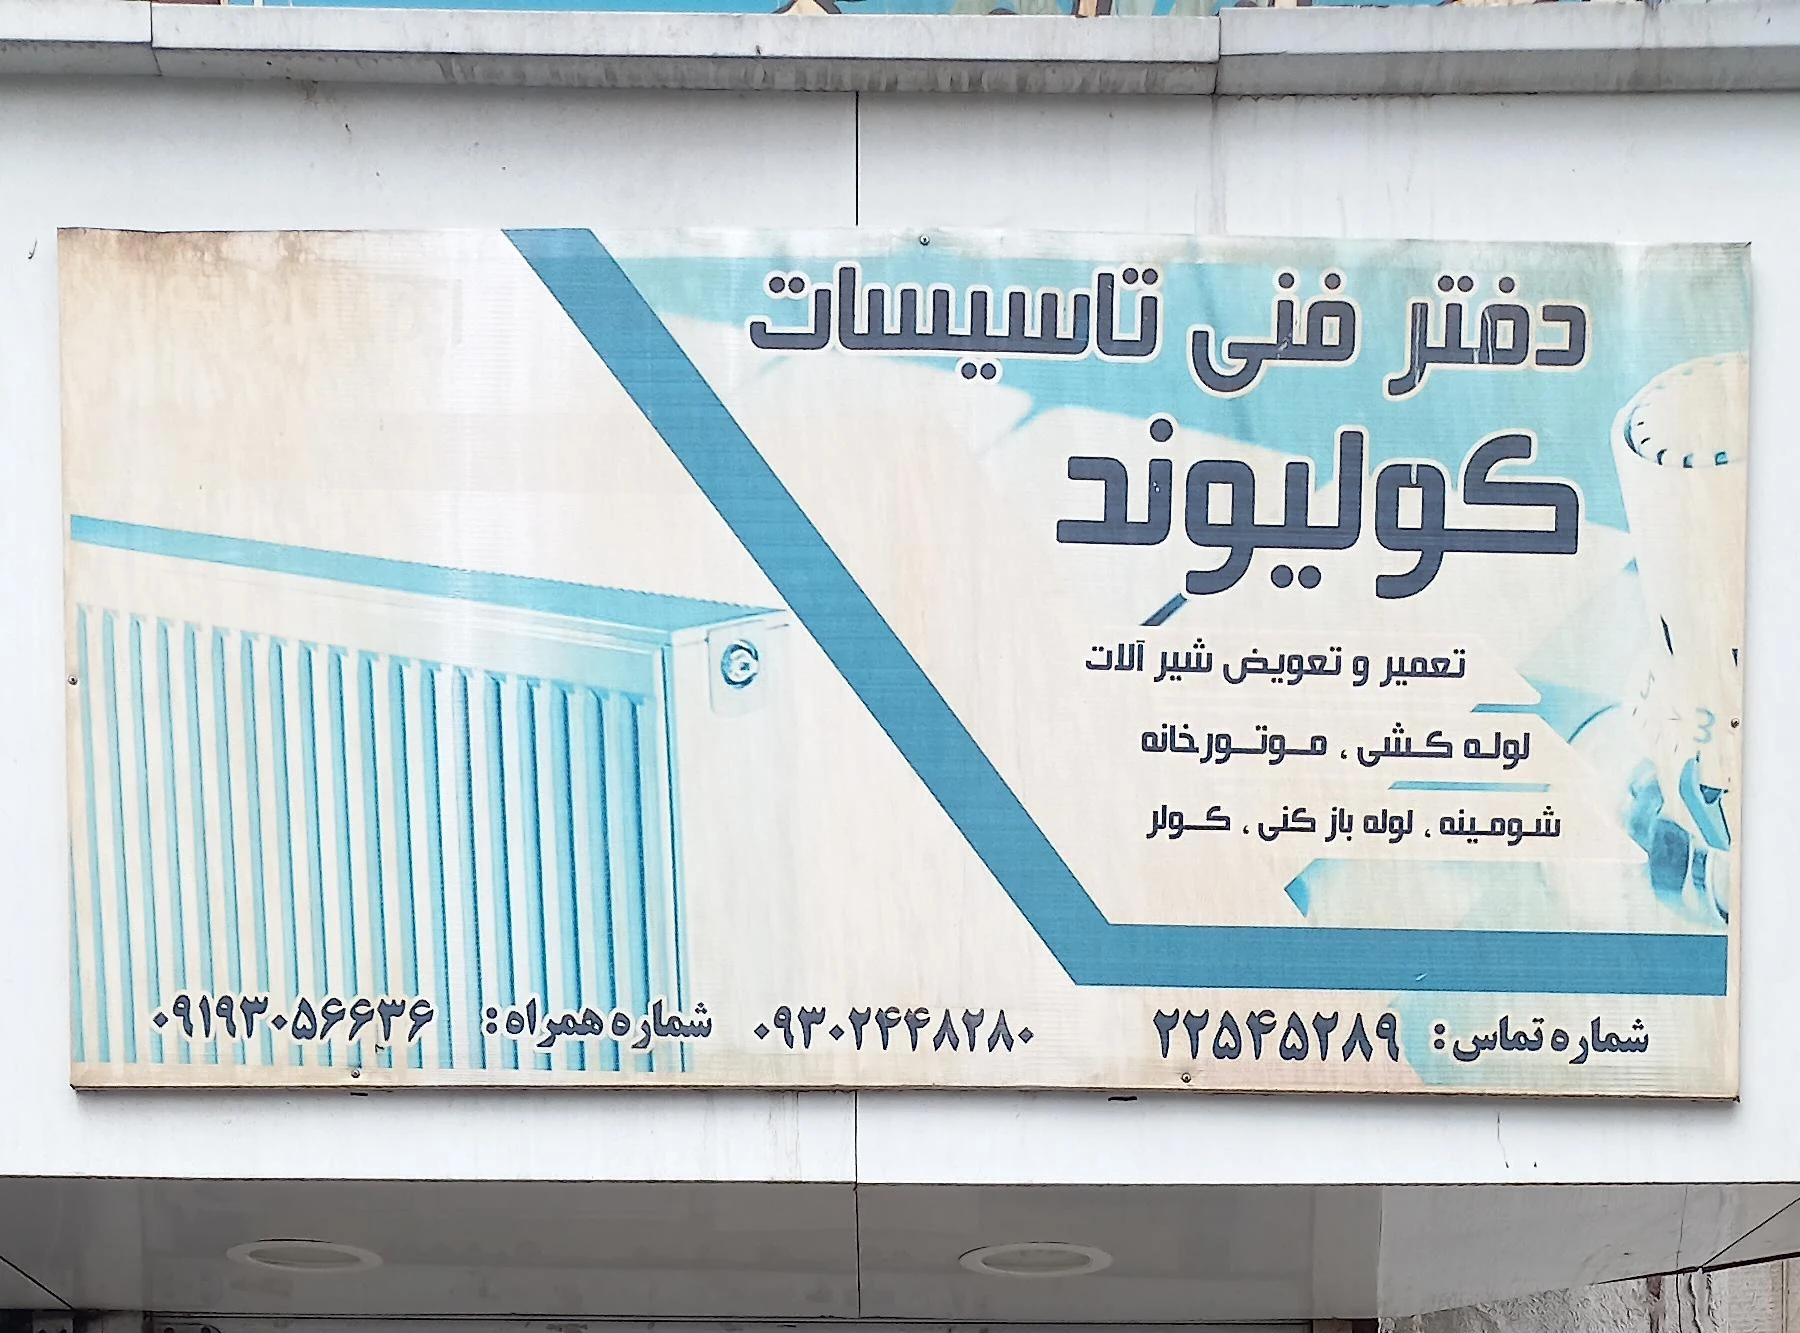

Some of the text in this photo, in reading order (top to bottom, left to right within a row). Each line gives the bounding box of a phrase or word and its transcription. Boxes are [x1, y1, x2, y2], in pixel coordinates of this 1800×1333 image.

[750, 266, 1587, 396] دفتر فنی تاسیسات
[1056, 418, 1580, 600] کولیوند
[1085, 638, 1466, 688] تعمیر و تعویض شیر آلات
[1141, 723, 1328, 766] موتورخانه
[1463, 731, 1530, 770] لوله
[1146, 804, 1231, 839] کولر
[1363, 808, 1414, 844] لوله
[152, 993, 713, 1050] شماره همراه: ۰۹۱۹۳۰۵۶۶۳۶
[753, 1005, 1034, 1053] ۰۹۳۰۲۴۴۸۲۸۰
[1152, 1008, 1649, 1065] شماره تماس: ۲۲۵۴۵۲۸۹
